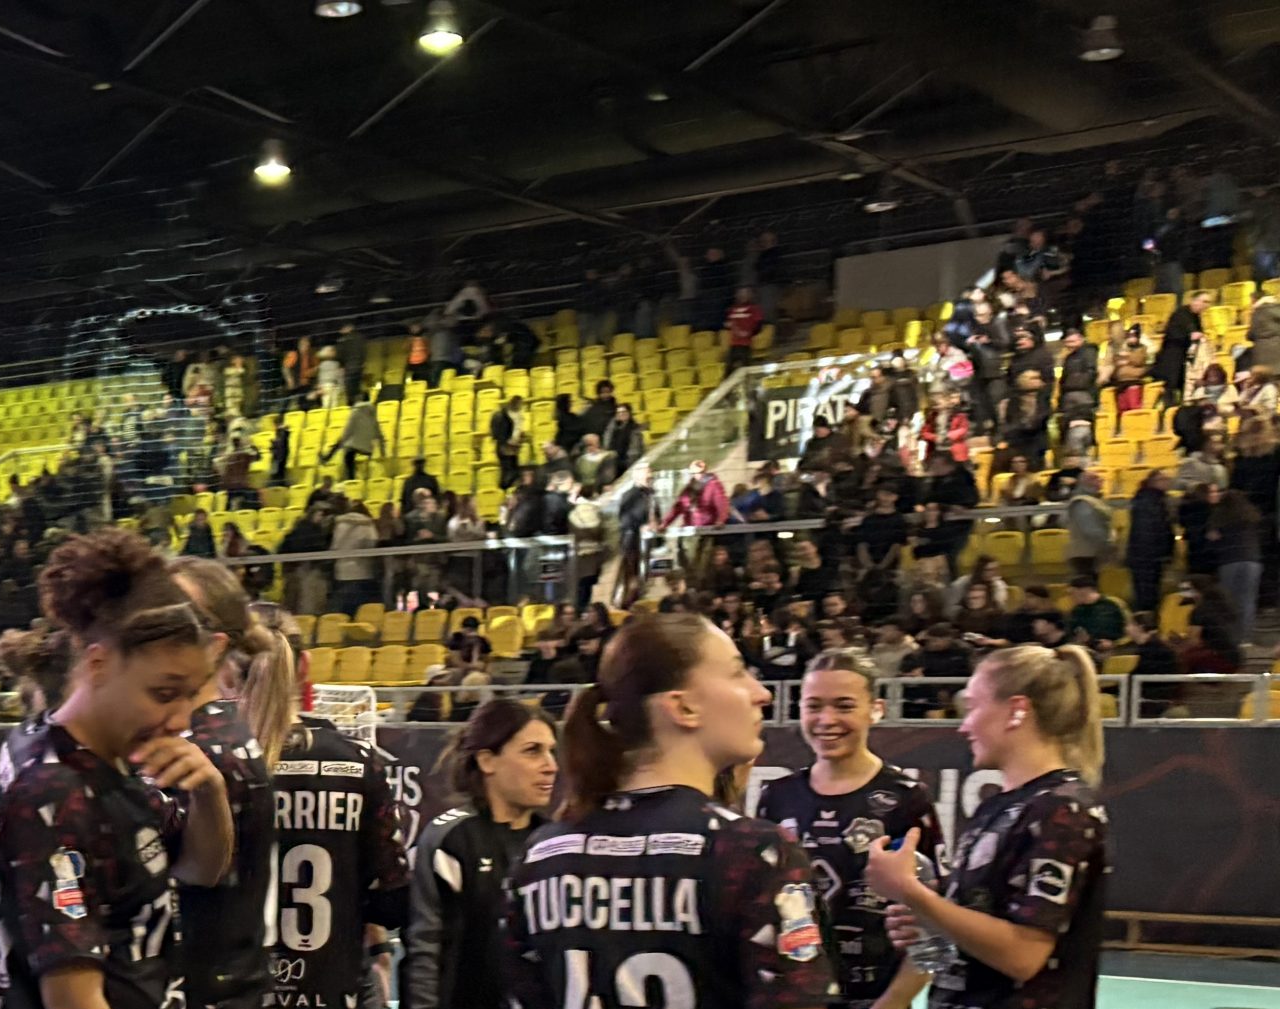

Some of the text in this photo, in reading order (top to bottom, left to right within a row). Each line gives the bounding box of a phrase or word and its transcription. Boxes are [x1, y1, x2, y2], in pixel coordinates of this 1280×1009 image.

[764, 394, 851, 440] PIRAT
[273, 790, 363, 831] RRIER
[518, 875, 702, 935] TUCCELLA
[262, 993, 327, 1007] VAL
